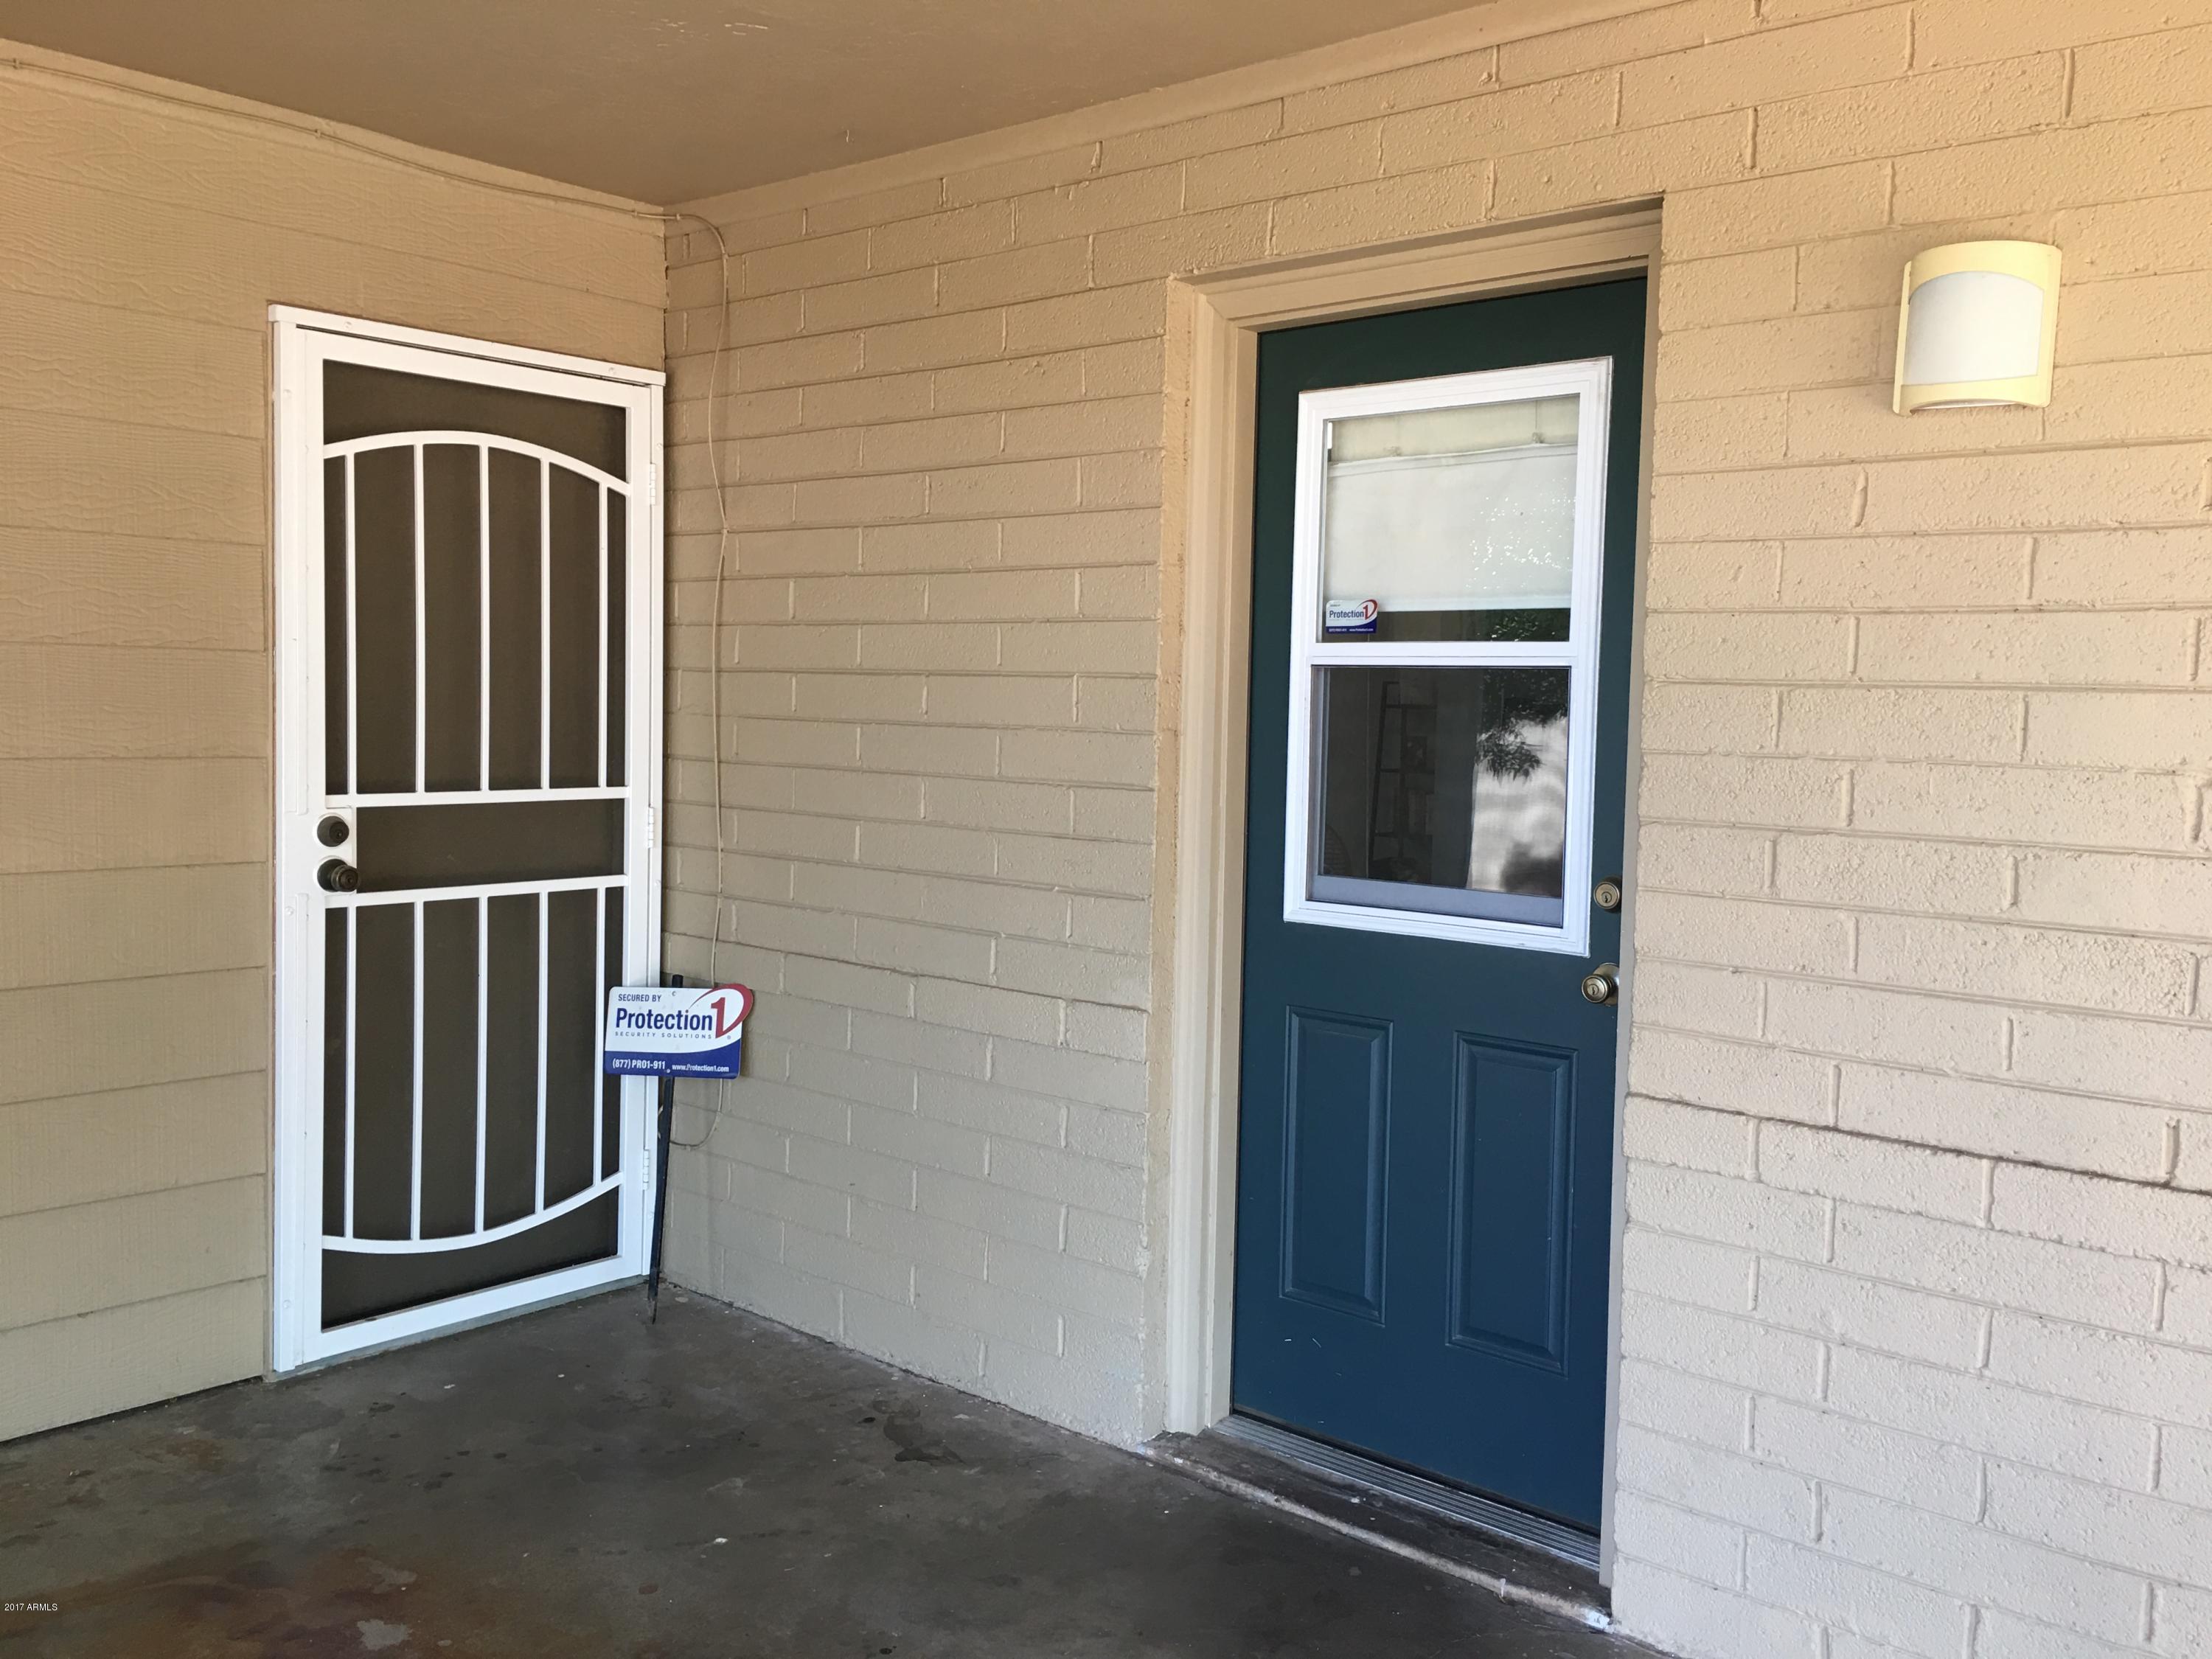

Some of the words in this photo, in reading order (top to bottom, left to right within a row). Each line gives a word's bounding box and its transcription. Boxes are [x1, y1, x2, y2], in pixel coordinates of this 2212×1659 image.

[1329, 610, 1364, 618] Protection
[616, 1008, 712, 1031] Protection
[612, 1058, 630, 1068] (877)
[672, 1064, 729, 1073] www.Protection1.com
